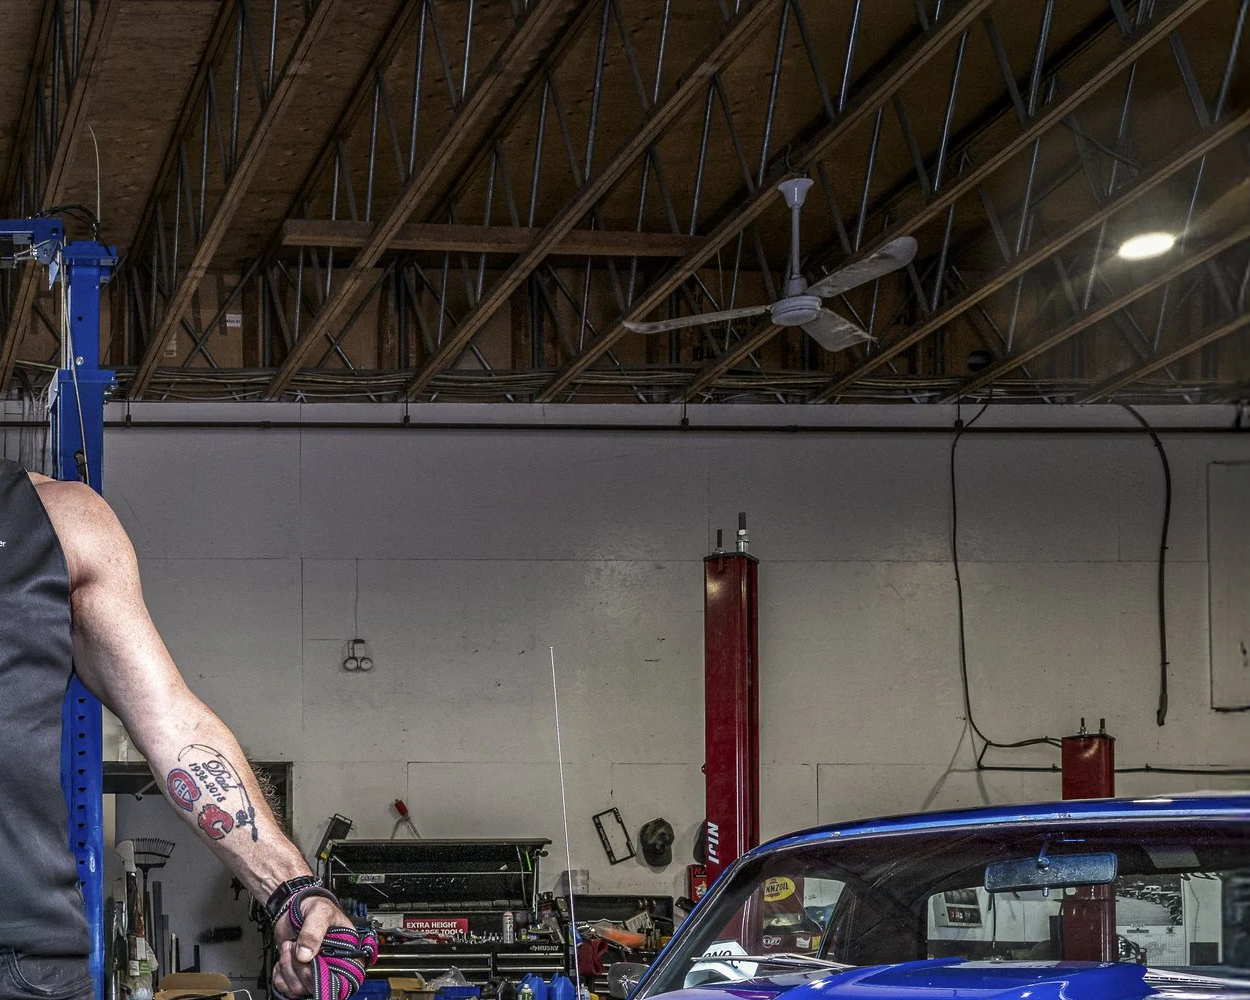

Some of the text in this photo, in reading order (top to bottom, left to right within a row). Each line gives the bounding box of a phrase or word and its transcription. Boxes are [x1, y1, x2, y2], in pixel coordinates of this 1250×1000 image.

[188, 762, 227, 803] 1938-2018
[202, 760, 237, 792] Dad
[406, 921, 430, 929] EXTRA
